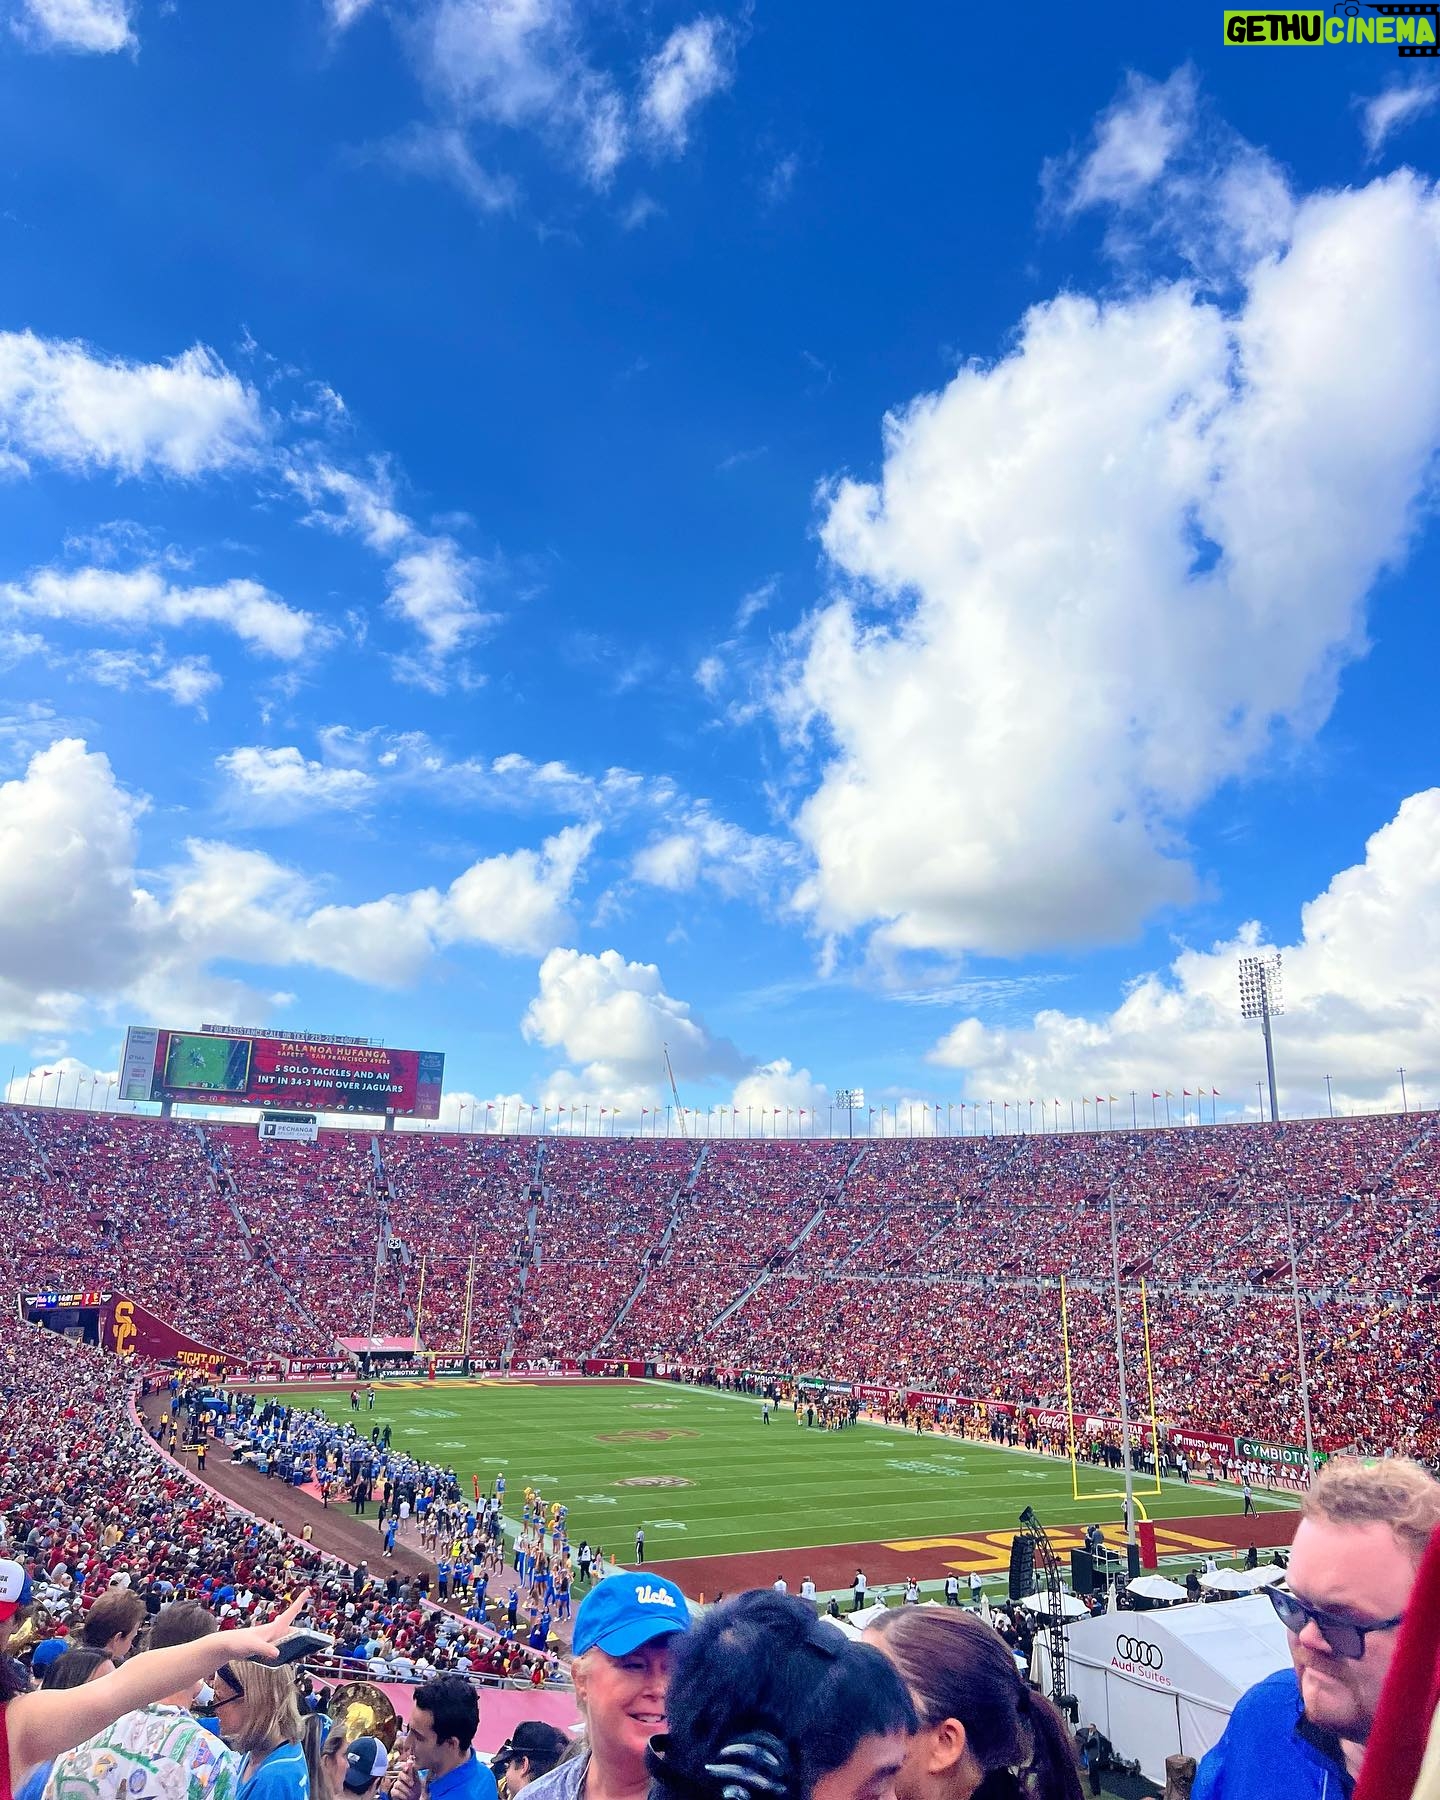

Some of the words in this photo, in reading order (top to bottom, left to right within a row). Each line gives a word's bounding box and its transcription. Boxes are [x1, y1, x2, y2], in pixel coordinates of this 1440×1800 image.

[225, 1026, 262, 1036] ASSISTANCE
[280, 1043, 333, 1055] TALANOA
[336, 1048, 387, 1059] HUFANGA
[327, 1055, 367, 1063] FRANCISCO
[283, 1065, 309, 1074] SOLO
[311, 1067, 351, 1077] TACKLES
[353, 1070, 374, 1079] AND
[376, 1072, 390, 1080] AN
[258, 1075, 276, 1084] INT
[277, 1077, 288, 1085] IN
[291, 1078, 311, 1086] 34-3
[313, 1079, 333, 1088] WIN
[335, 1080, 360, 1090] OVER
[361, 1082, 403, 1093] JAGUARS
[278, 1125, 313, 1133] PECHANGA
[390, 1239, 399, 1247] 25
[1111, 1656, 1135, 1673] Audi
[1138, 1665, 1172, 1687] Suites
